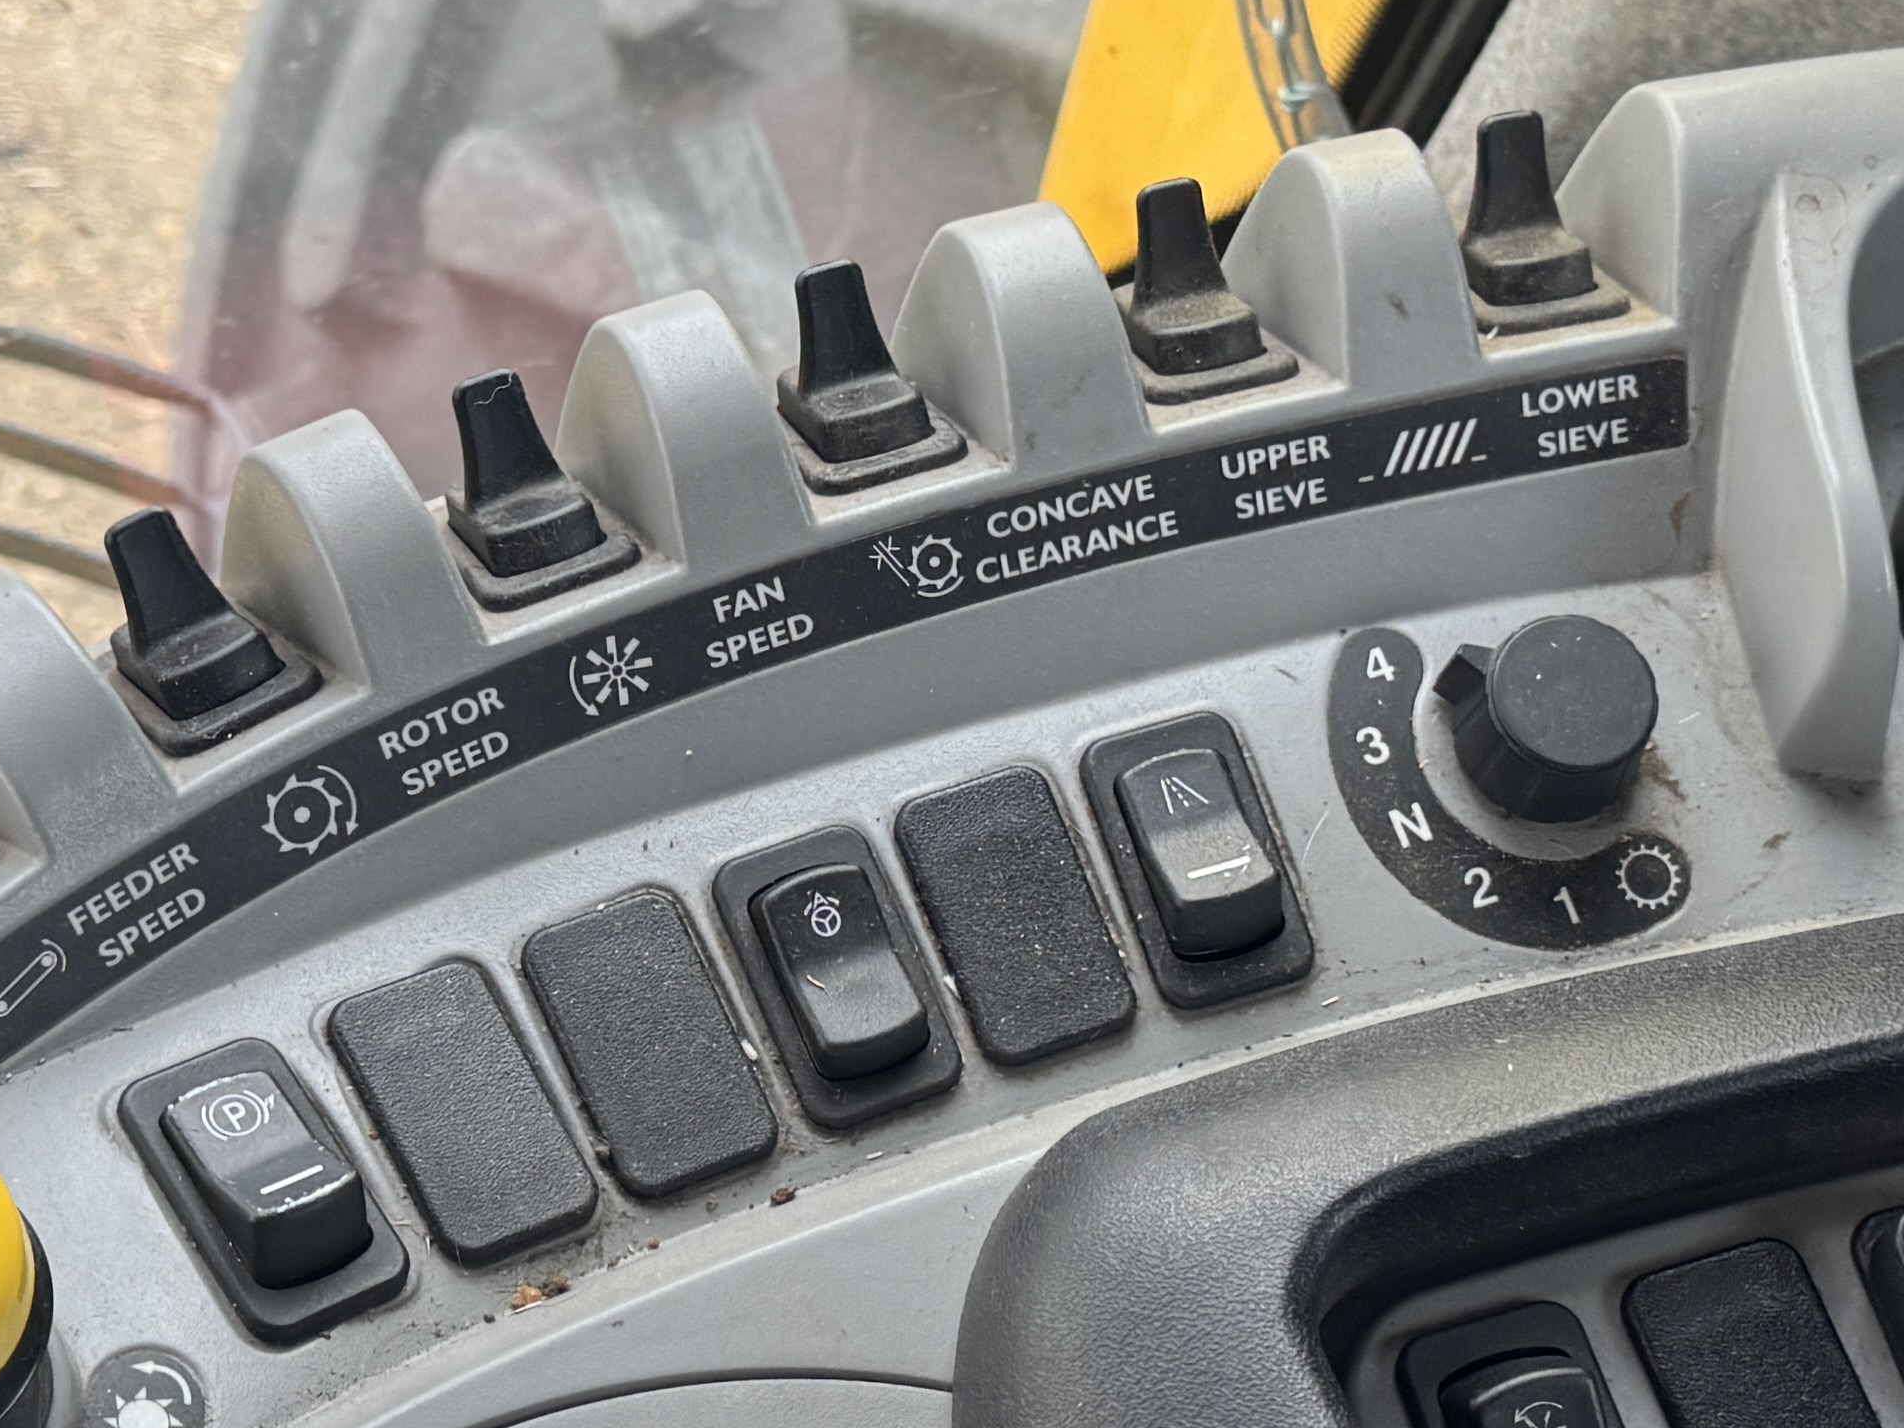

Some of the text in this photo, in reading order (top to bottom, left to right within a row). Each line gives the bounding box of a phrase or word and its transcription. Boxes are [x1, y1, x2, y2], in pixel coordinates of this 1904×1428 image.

[1520, 374, 1639, 418] LOWER
[1220, 434, 1331, 481] UPPER
[1537, 418, 1629, 461] SIEVE
[986, 474, 1156, 539] CONCAVE
[1234, 478, 1327, 522] SIEVE
[975, 509, 1179, 586] CLEARANCE
[712, 576, 787, 626] FAN
[706, 612, 815, 670] SPEED
[1366, 647, 1395, 682] 4
[378, 686, 506, 760] ROTOR
[1356, 726, 1390, 765] 3
[401, 730, 510, 797] SPEED
[1388, 802, 1433, 849] N
[65, 842, 199, 936] FEEDER
[1464, 866, 1499, 909] 2
[1553, 886, 1581, 924] 1
[98, 888, 206, 968] SPEED
[222, 1101, 246, 1131] P
